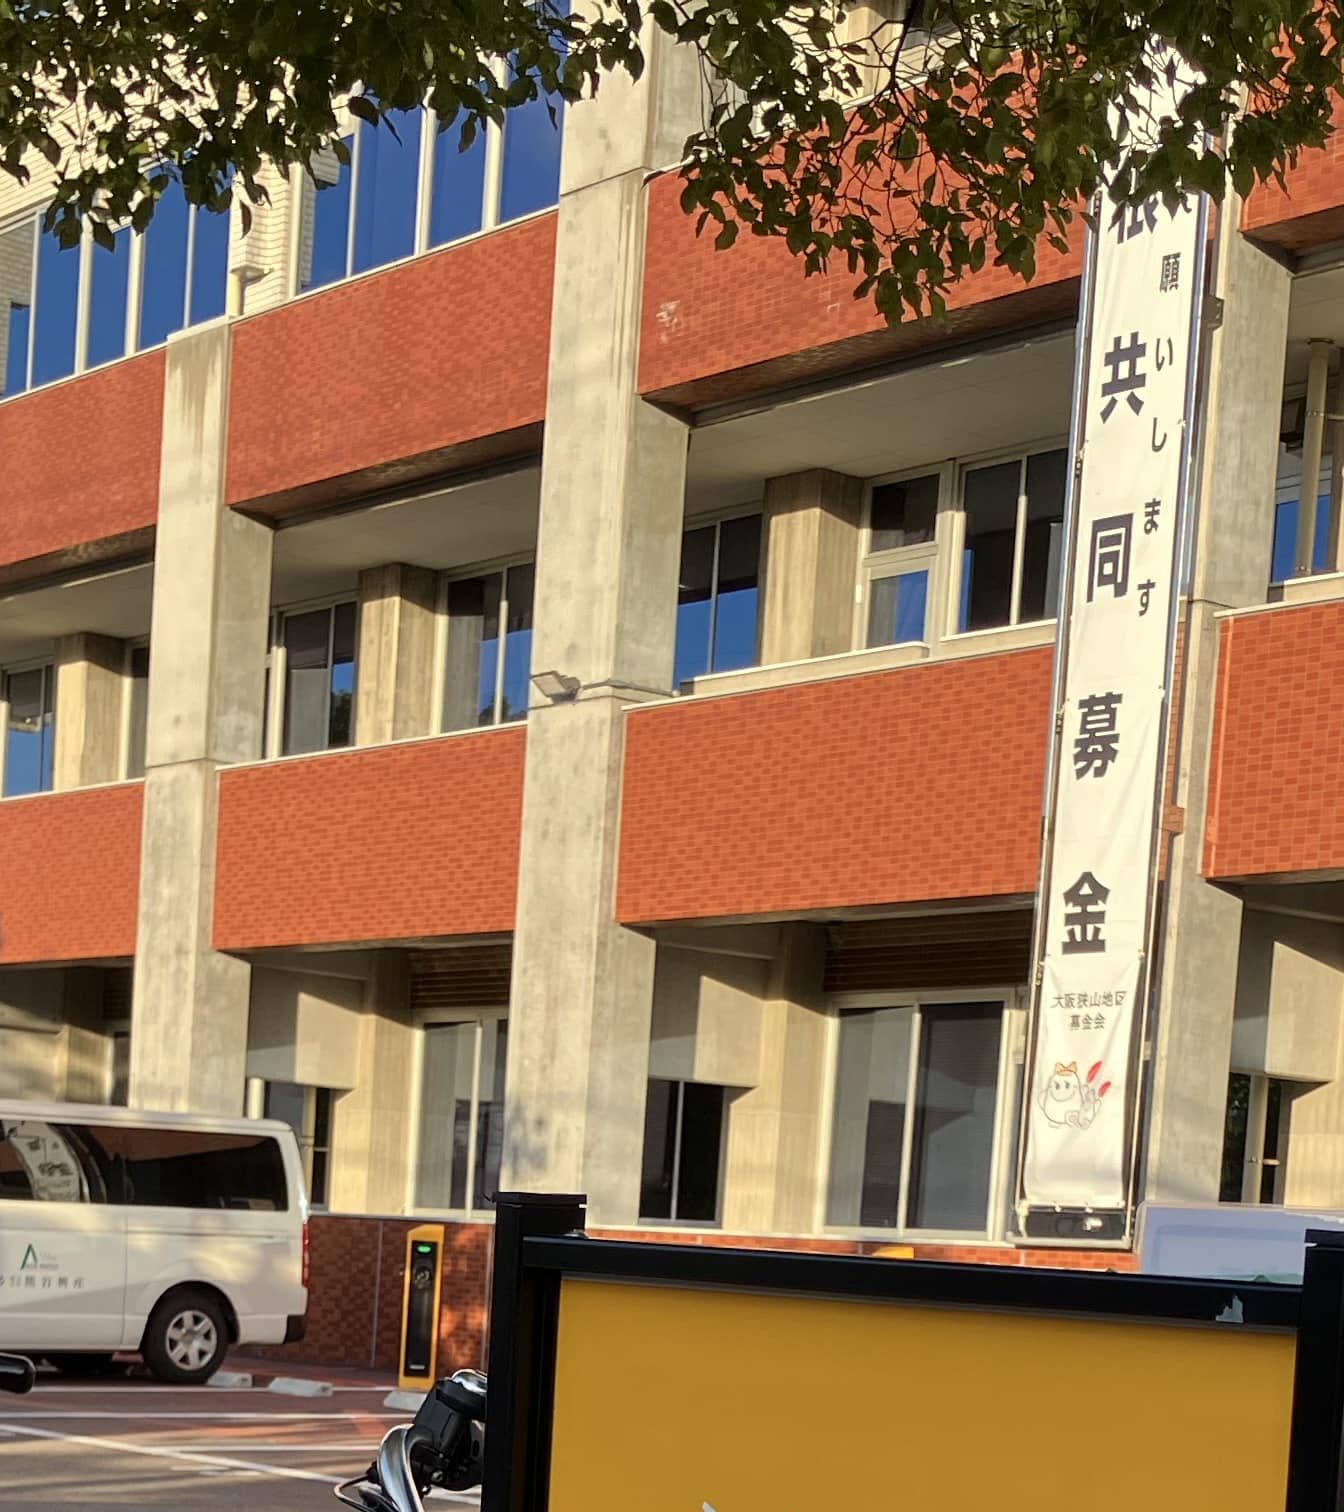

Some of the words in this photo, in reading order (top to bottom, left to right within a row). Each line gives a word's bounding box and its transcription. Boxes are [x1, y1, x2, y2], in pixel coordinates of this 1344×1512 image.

[1137, 192, 1193, 617] 願いします
